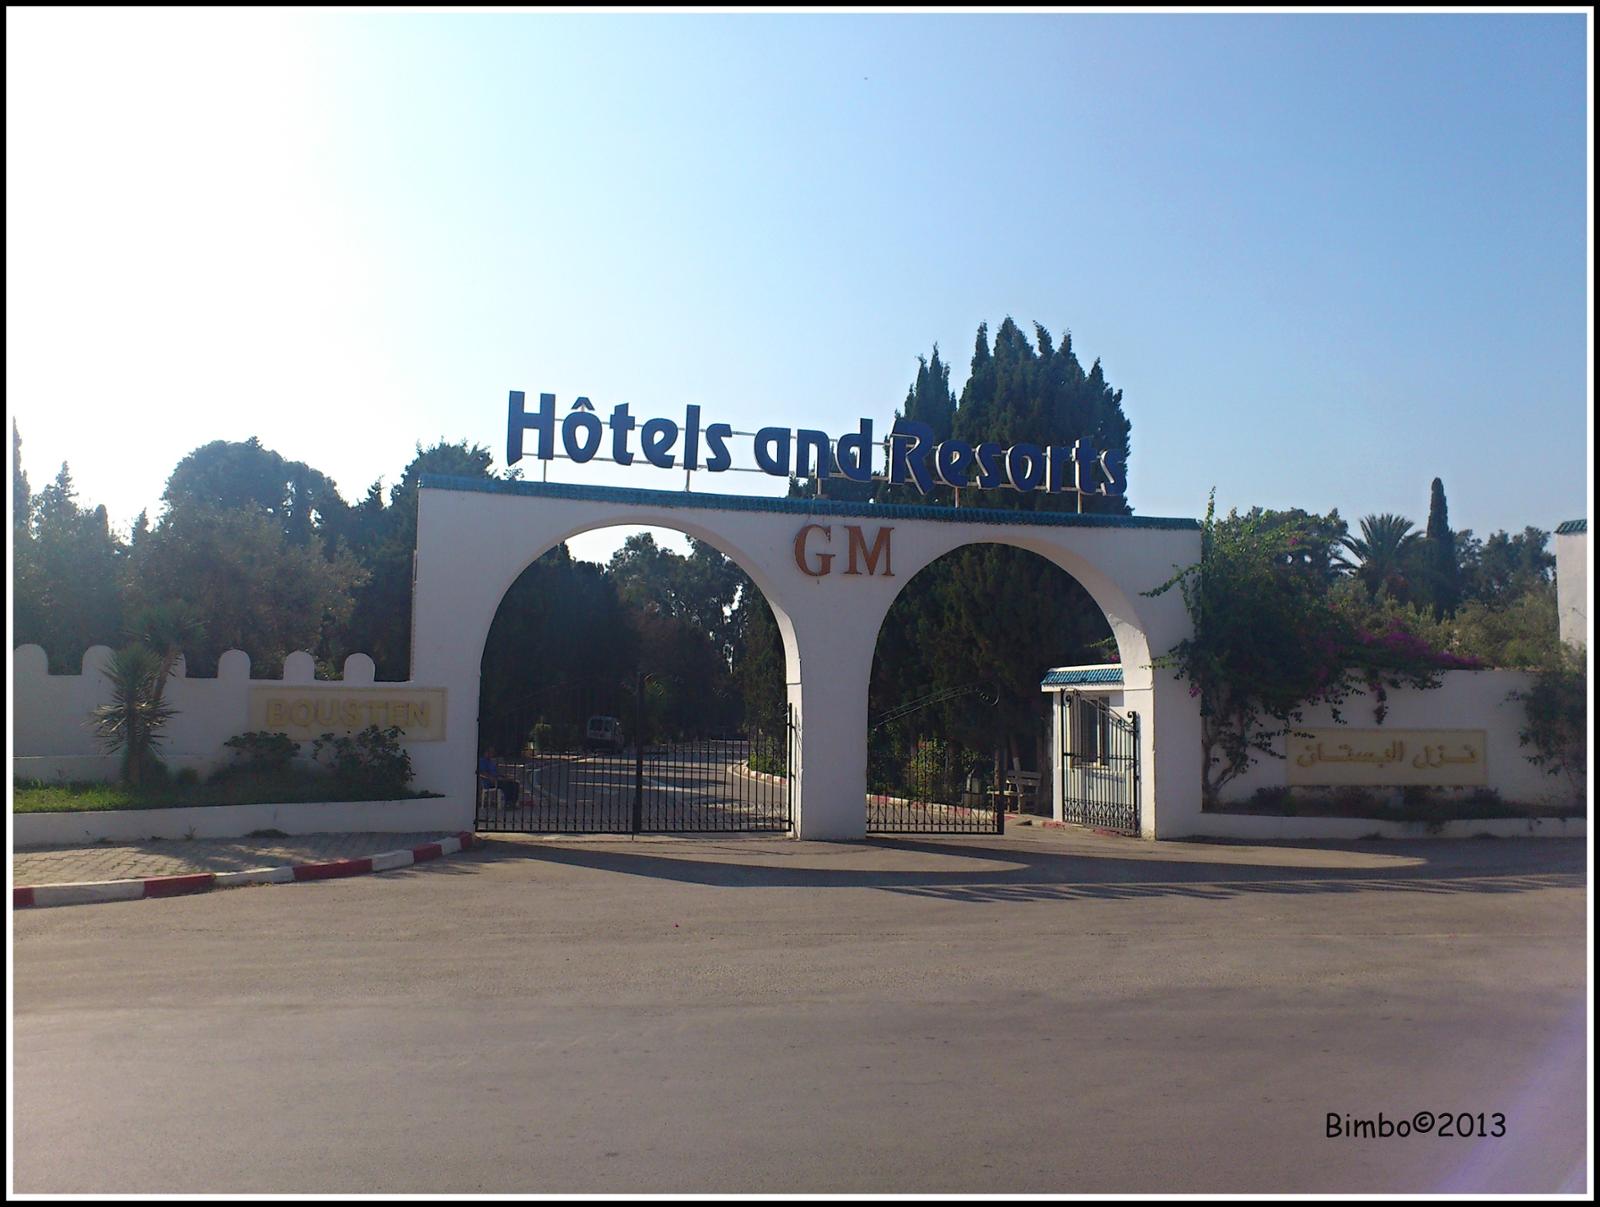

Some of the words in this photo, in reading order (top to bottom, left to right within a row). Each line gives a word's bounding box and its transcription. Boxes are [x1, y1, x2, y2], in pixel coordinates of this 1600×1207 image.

[507, 391, 732, 472] Hôtels
[753, 418, 872, 482] and
[889, 420, 1127, 496] Resorts
[794, 523, 895, 576] GM
[267, 698, 431, 728] BOUSTEN
[1296, 740, 1404, 768] البستان
